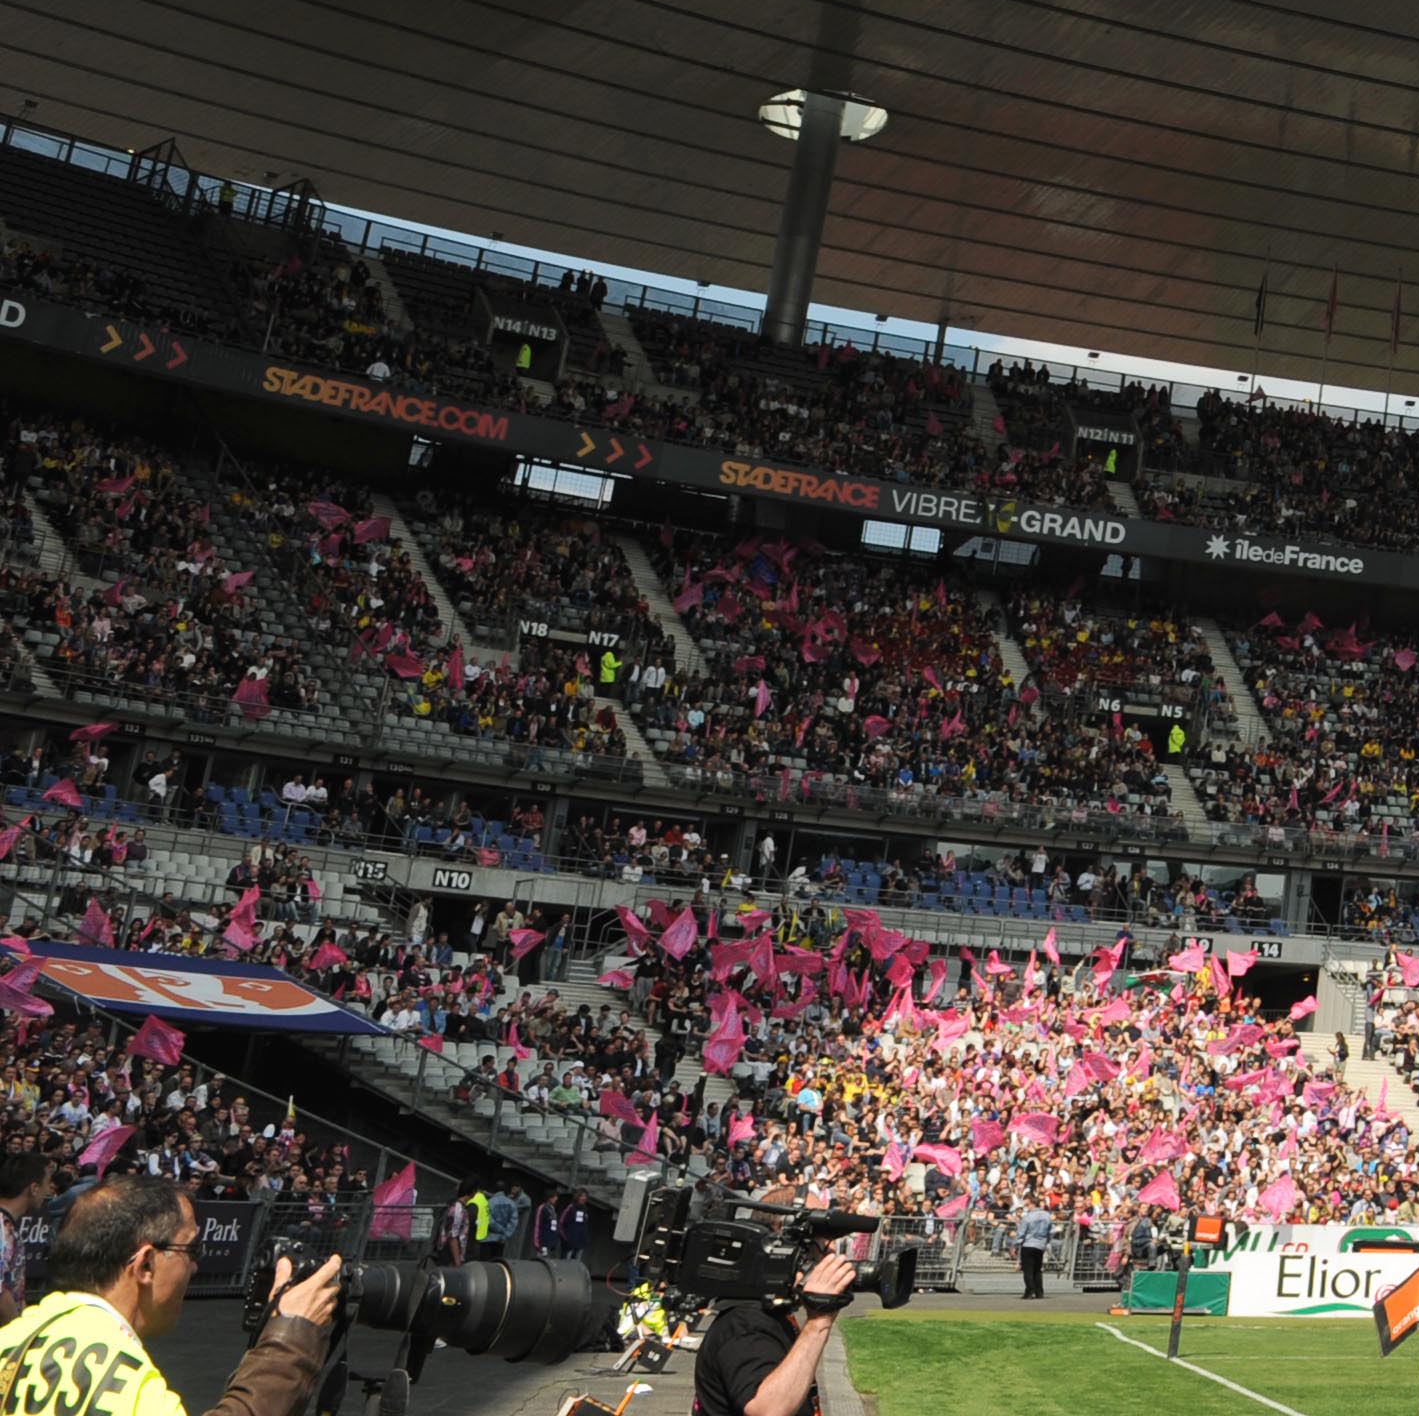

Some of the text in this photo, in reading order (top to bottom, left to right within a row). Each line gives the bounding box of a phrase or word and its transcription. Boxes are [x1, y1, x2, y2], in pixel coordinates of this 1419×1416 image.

[494, 316, 558, 342] N14 N13
[262, 366, 510, 441] STADEFRANCE.COM
[1077, 426, 1135, 446] N12 N11
[719, 460, 881, 509] STADEFRANCE
[520, 619, 620, 648] N18 N17
[1098, 696, 1184, 719] N6 N5
[434, 868, 472, 890] N10
[19, 1216, 241, 1244] Ede Park
[1277, 1255, 1381, 1299] Elior
